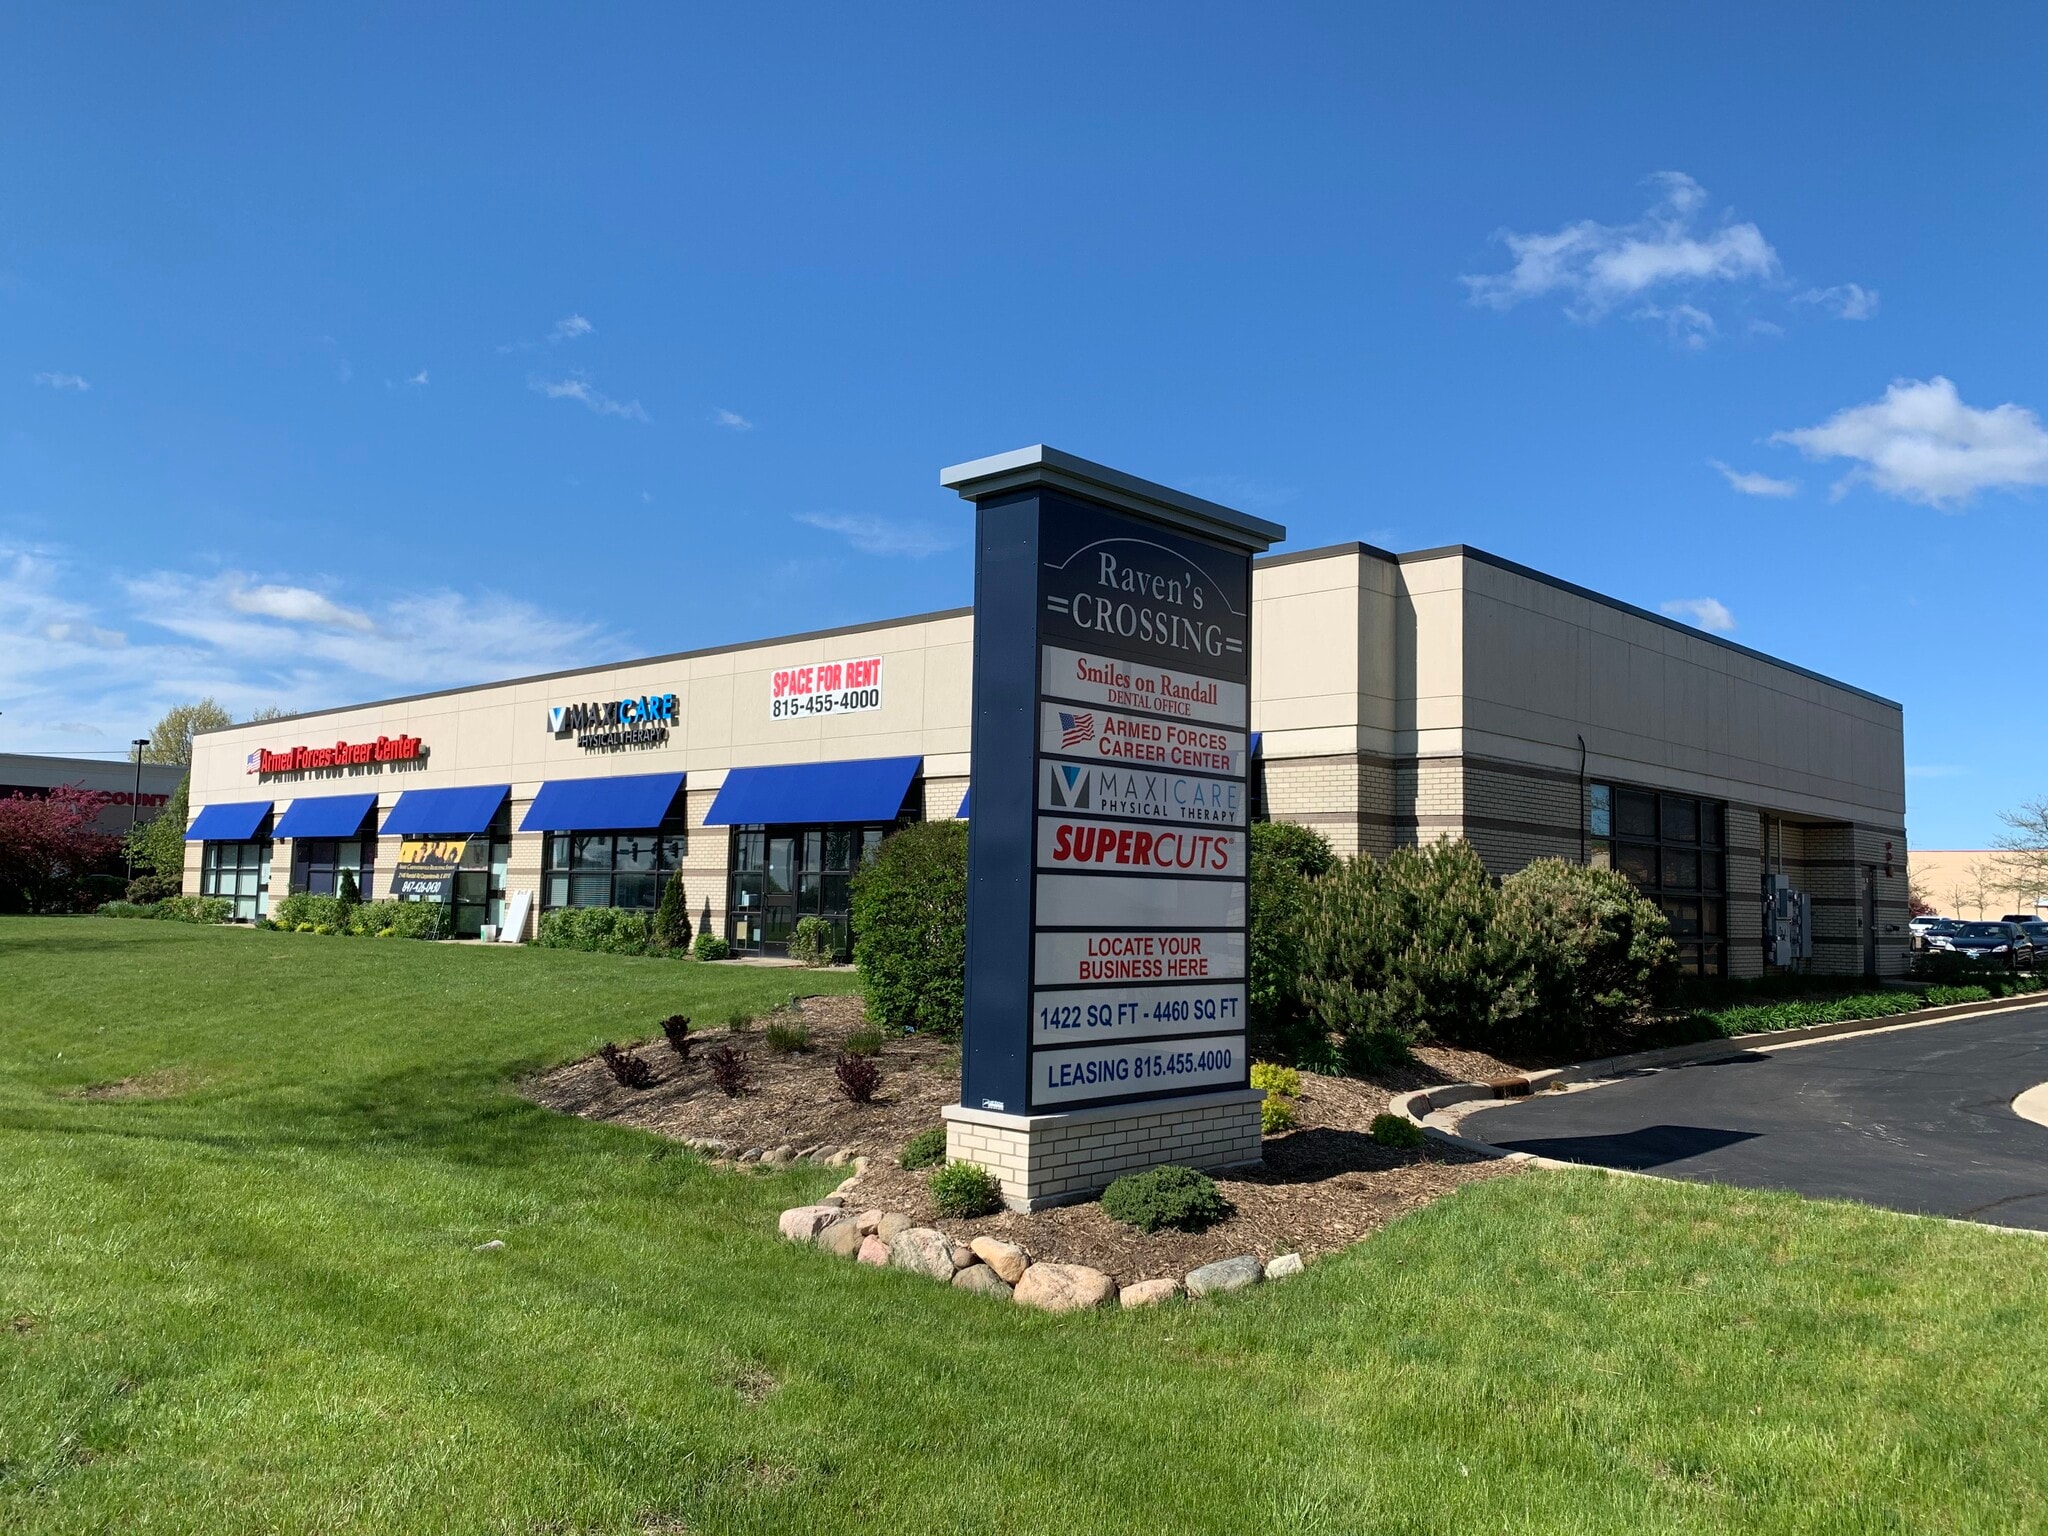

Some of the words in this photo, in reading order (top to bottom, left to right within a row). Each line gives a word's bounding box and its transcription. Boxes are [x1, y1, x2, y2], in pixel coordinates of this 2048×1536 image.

[1098, 552, 1203, 609] Raven's
[1072, 592, 1222, 656] CROSSING
[773, 668, 813, 698] SPACE
[816, 664, 841, 692] FOR
[846, 659, 880, 689] RENT
[1077, 658, 1131, 688] Smiles
[1135, 677, 1155, 693] on
[1160, 675, 1218, 705] Randall
[570, 694, 673, 729] MAXICARE
[773, 689, 879, 717] 815-455-4000
[1108, 689, 1151, 709] DENTAL
[1154, 698, 1191, 716] OFFICE
[577, 732, 618, 748] PHYSICAL
[619, 727, 662, 744] THERAPY
[1104, 716, 1161, 741] ARMED
[1167, 726, 1227, 750] FORCES
[261, 749, 293, 772] Armed
[296, 746, 331, 768] Forces
[335, 741, 372, 764] Career
[375, 735, 418, 760] Center
[1099, 737, 1165, 762] CAREER
[1171, 747, 1230, 770] CENTER
[1099, 771, 1236, 809] MAXICARE
[1101, 799, 1168, 817] PHYSICAL
[1181, 807, 1235, 822] THERAPY
[1088, 937, 1153, 956] LOCATE
[1159, 937, 1201, 955] YOUR
[1079, 959, 1162, 980] BUSINESS
[1167, 958, 1208, 976] HERE
[1040, 1006, 1081, 1030] 1422
[1087, 1003, 1112, 1027] SQ
[1118, 1002, 1138, 1025] FT
[1153, 1000, 1189, 1022] 4460
[1194, 998, 1216, 1020] SQ
[1220, 997, 1238, 1018] FT
[1049, 1059, 1128, 1088] LEASING
[1134, 1049, 1232, 1079] 815.455.4000
